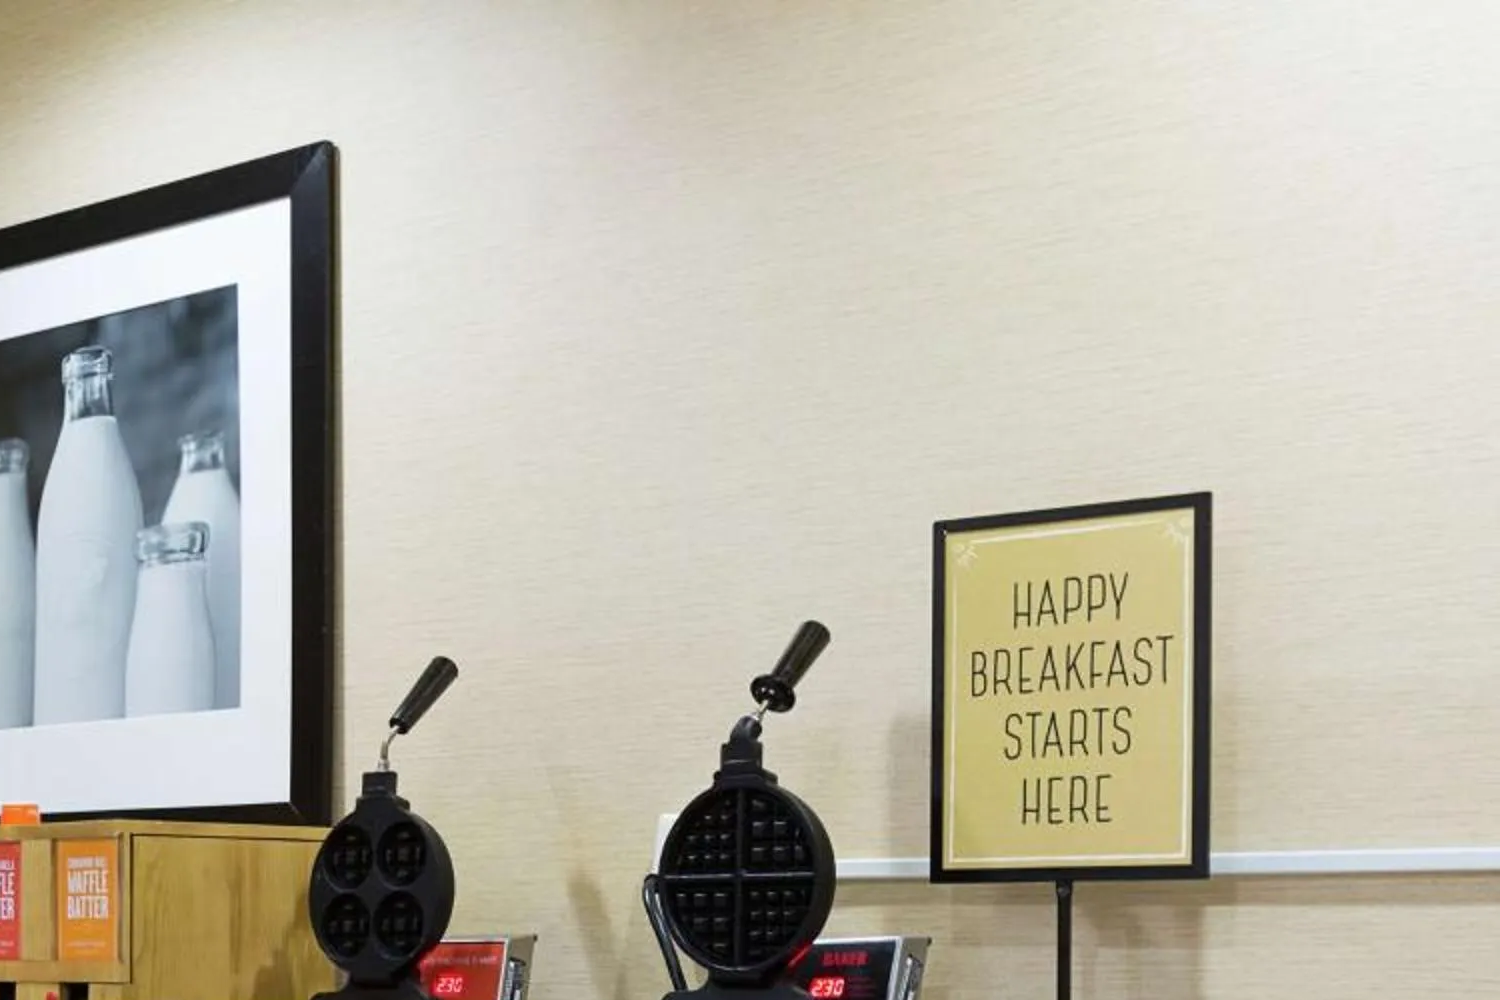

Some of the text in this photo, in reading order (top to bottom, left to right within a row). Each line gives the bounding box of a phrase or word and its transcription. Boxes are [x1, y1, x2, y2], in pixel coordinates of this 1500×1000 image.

[1013, 572, 1129, 629] HAPPY
[971, 635, 1174, 697] BREAKFAST
[1003, 706, 1132, 760] STARTS
[1021, 774, 1112, 825] HERE
[67, 869, 108, 894] WAFFLE
[67, 896, 108, 920] BATTER
